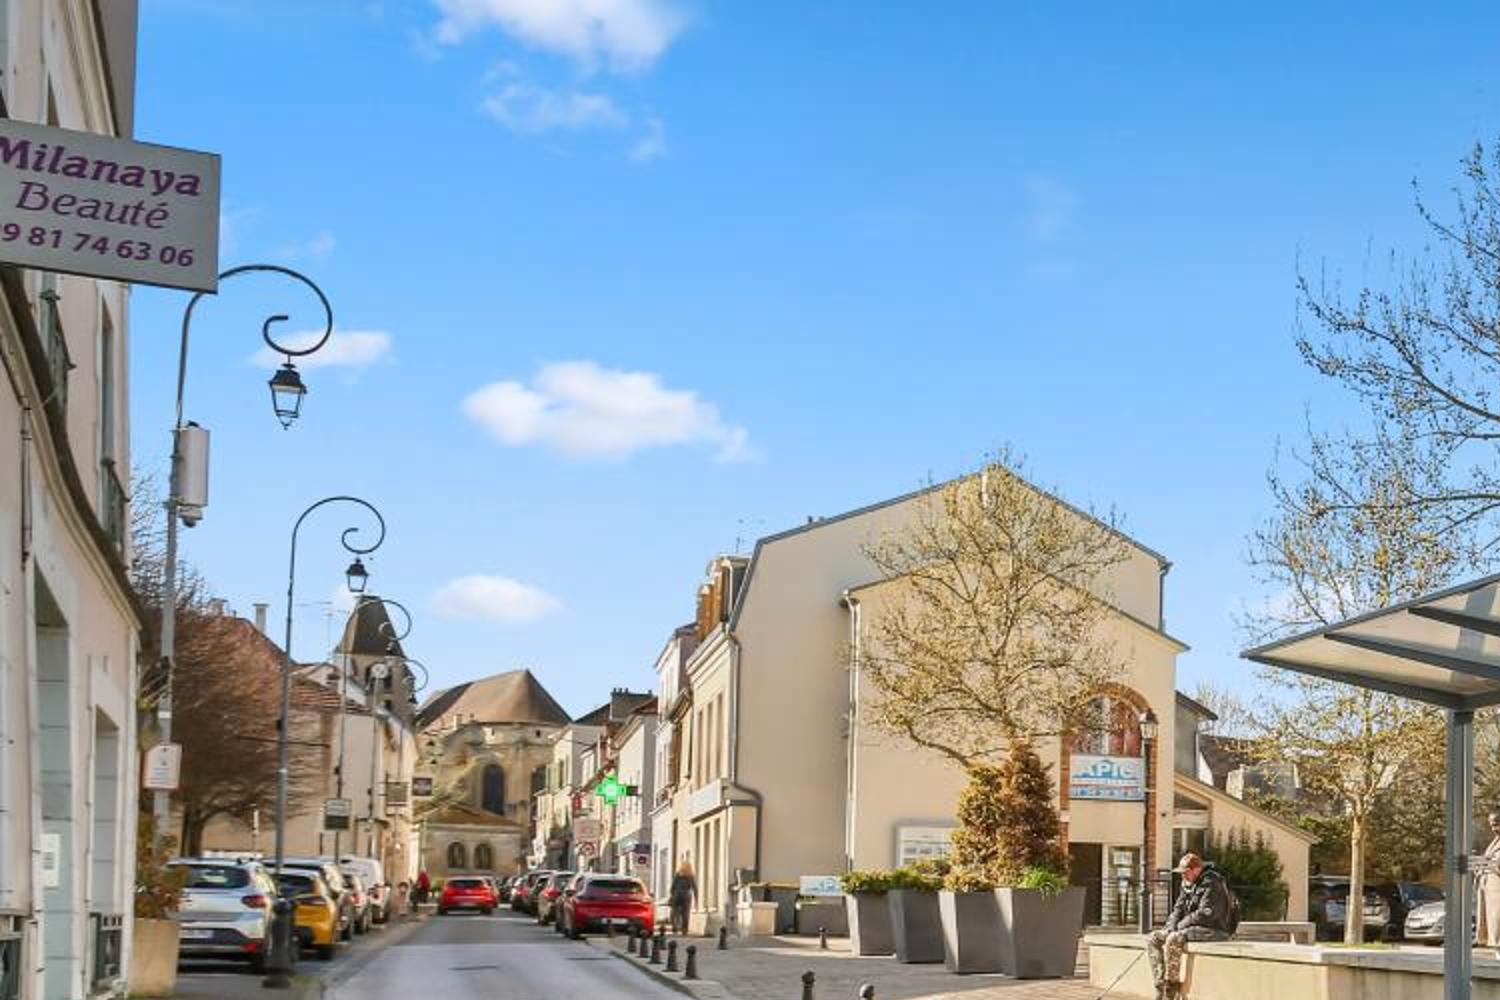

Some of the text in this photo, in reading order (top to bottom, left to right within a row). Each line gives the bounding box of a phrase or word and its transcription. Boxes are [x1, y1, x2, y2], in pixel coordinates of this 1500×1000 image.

[0, 135, 202, 197] Milanaya
[15, 181, 170, 229] Beauté
[28, 226, 63, 249] 81
[159, 245, 195, 267] 06
